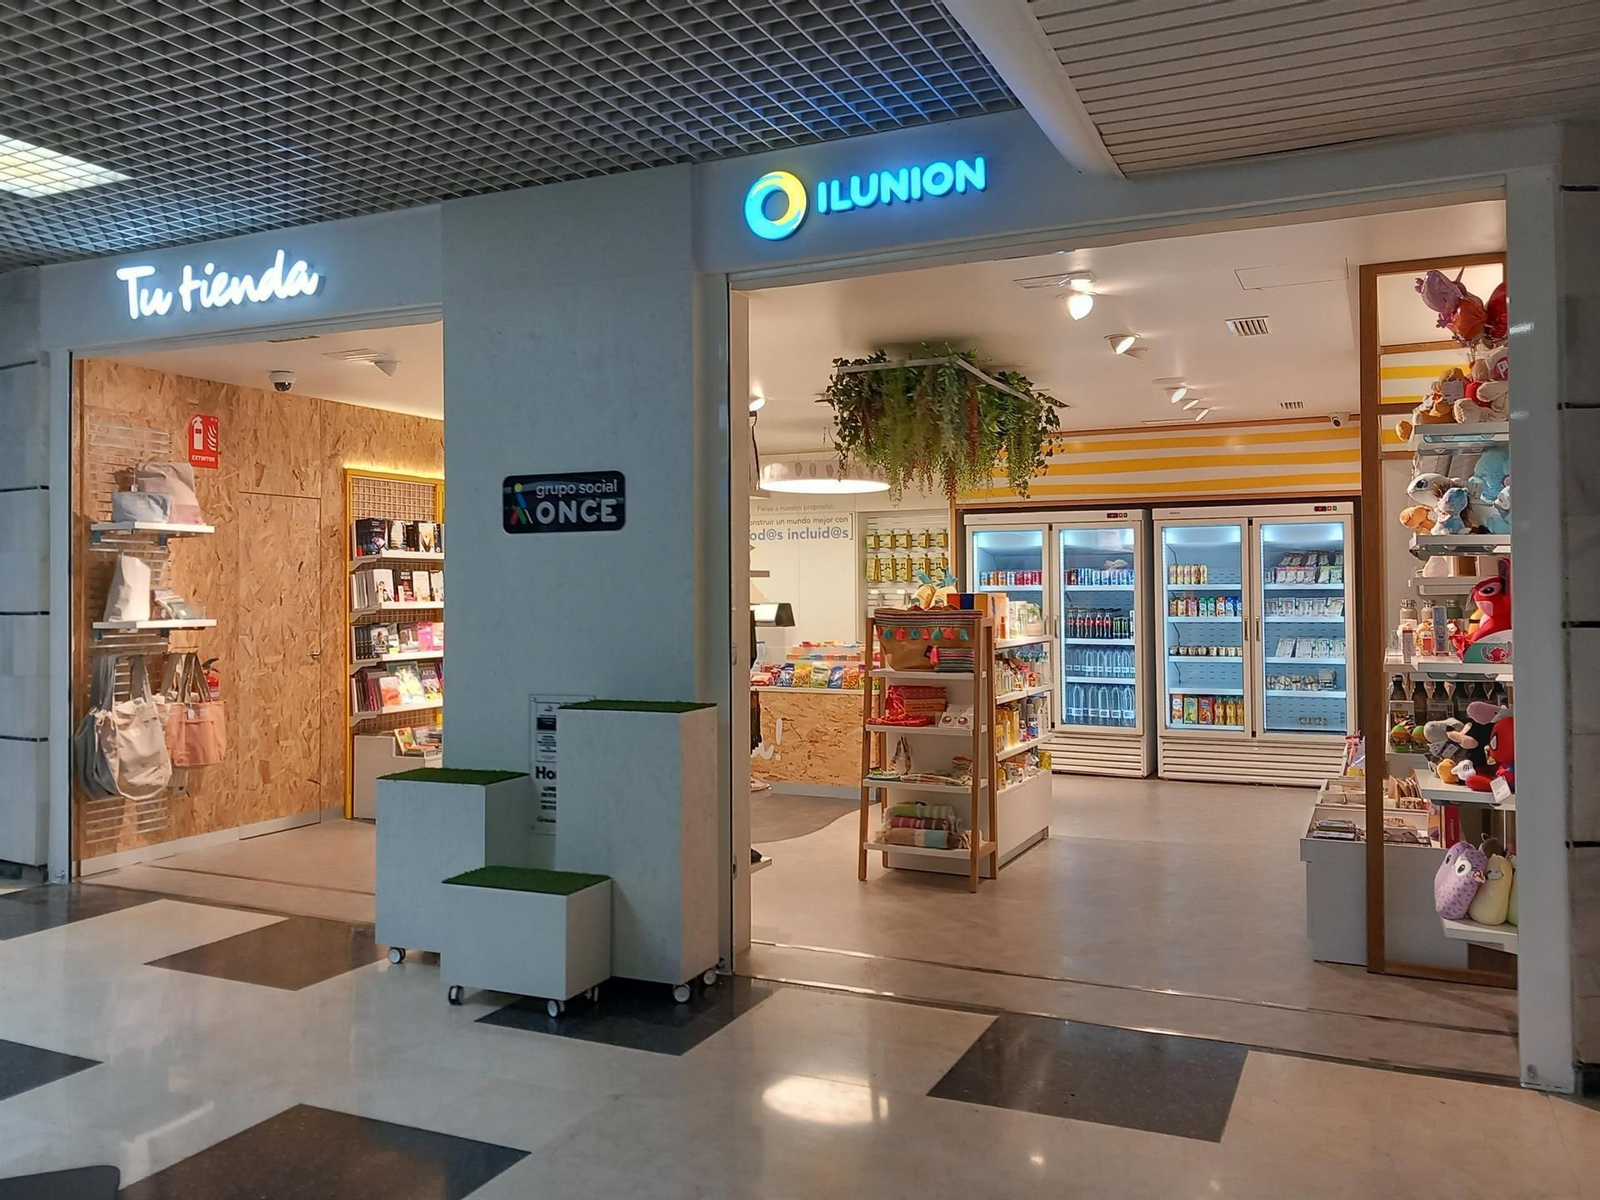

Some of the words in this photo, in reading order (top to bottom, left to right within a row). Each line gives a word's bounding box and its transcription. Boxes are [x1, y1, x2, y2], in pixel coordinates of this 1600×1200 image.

[817, 156, 986, 214] ILUNION
[116, 265, 173, 320] Tu
[178, 249, 319, 312] tienda
[191, 454, 215, 463] EXTINTOR
[536, 484, 577, 498] grupo
[578, 479, 618, 494] social
[535, 498, 618, 525] ONCE
[786, 516, 811, 525] mundo
[813, 517, 833, 525] mejor
[749, 528, 783, 540] od@s
[787, 526, 849, 540] incluid@s
[535, 765, 557, 780] Ho
